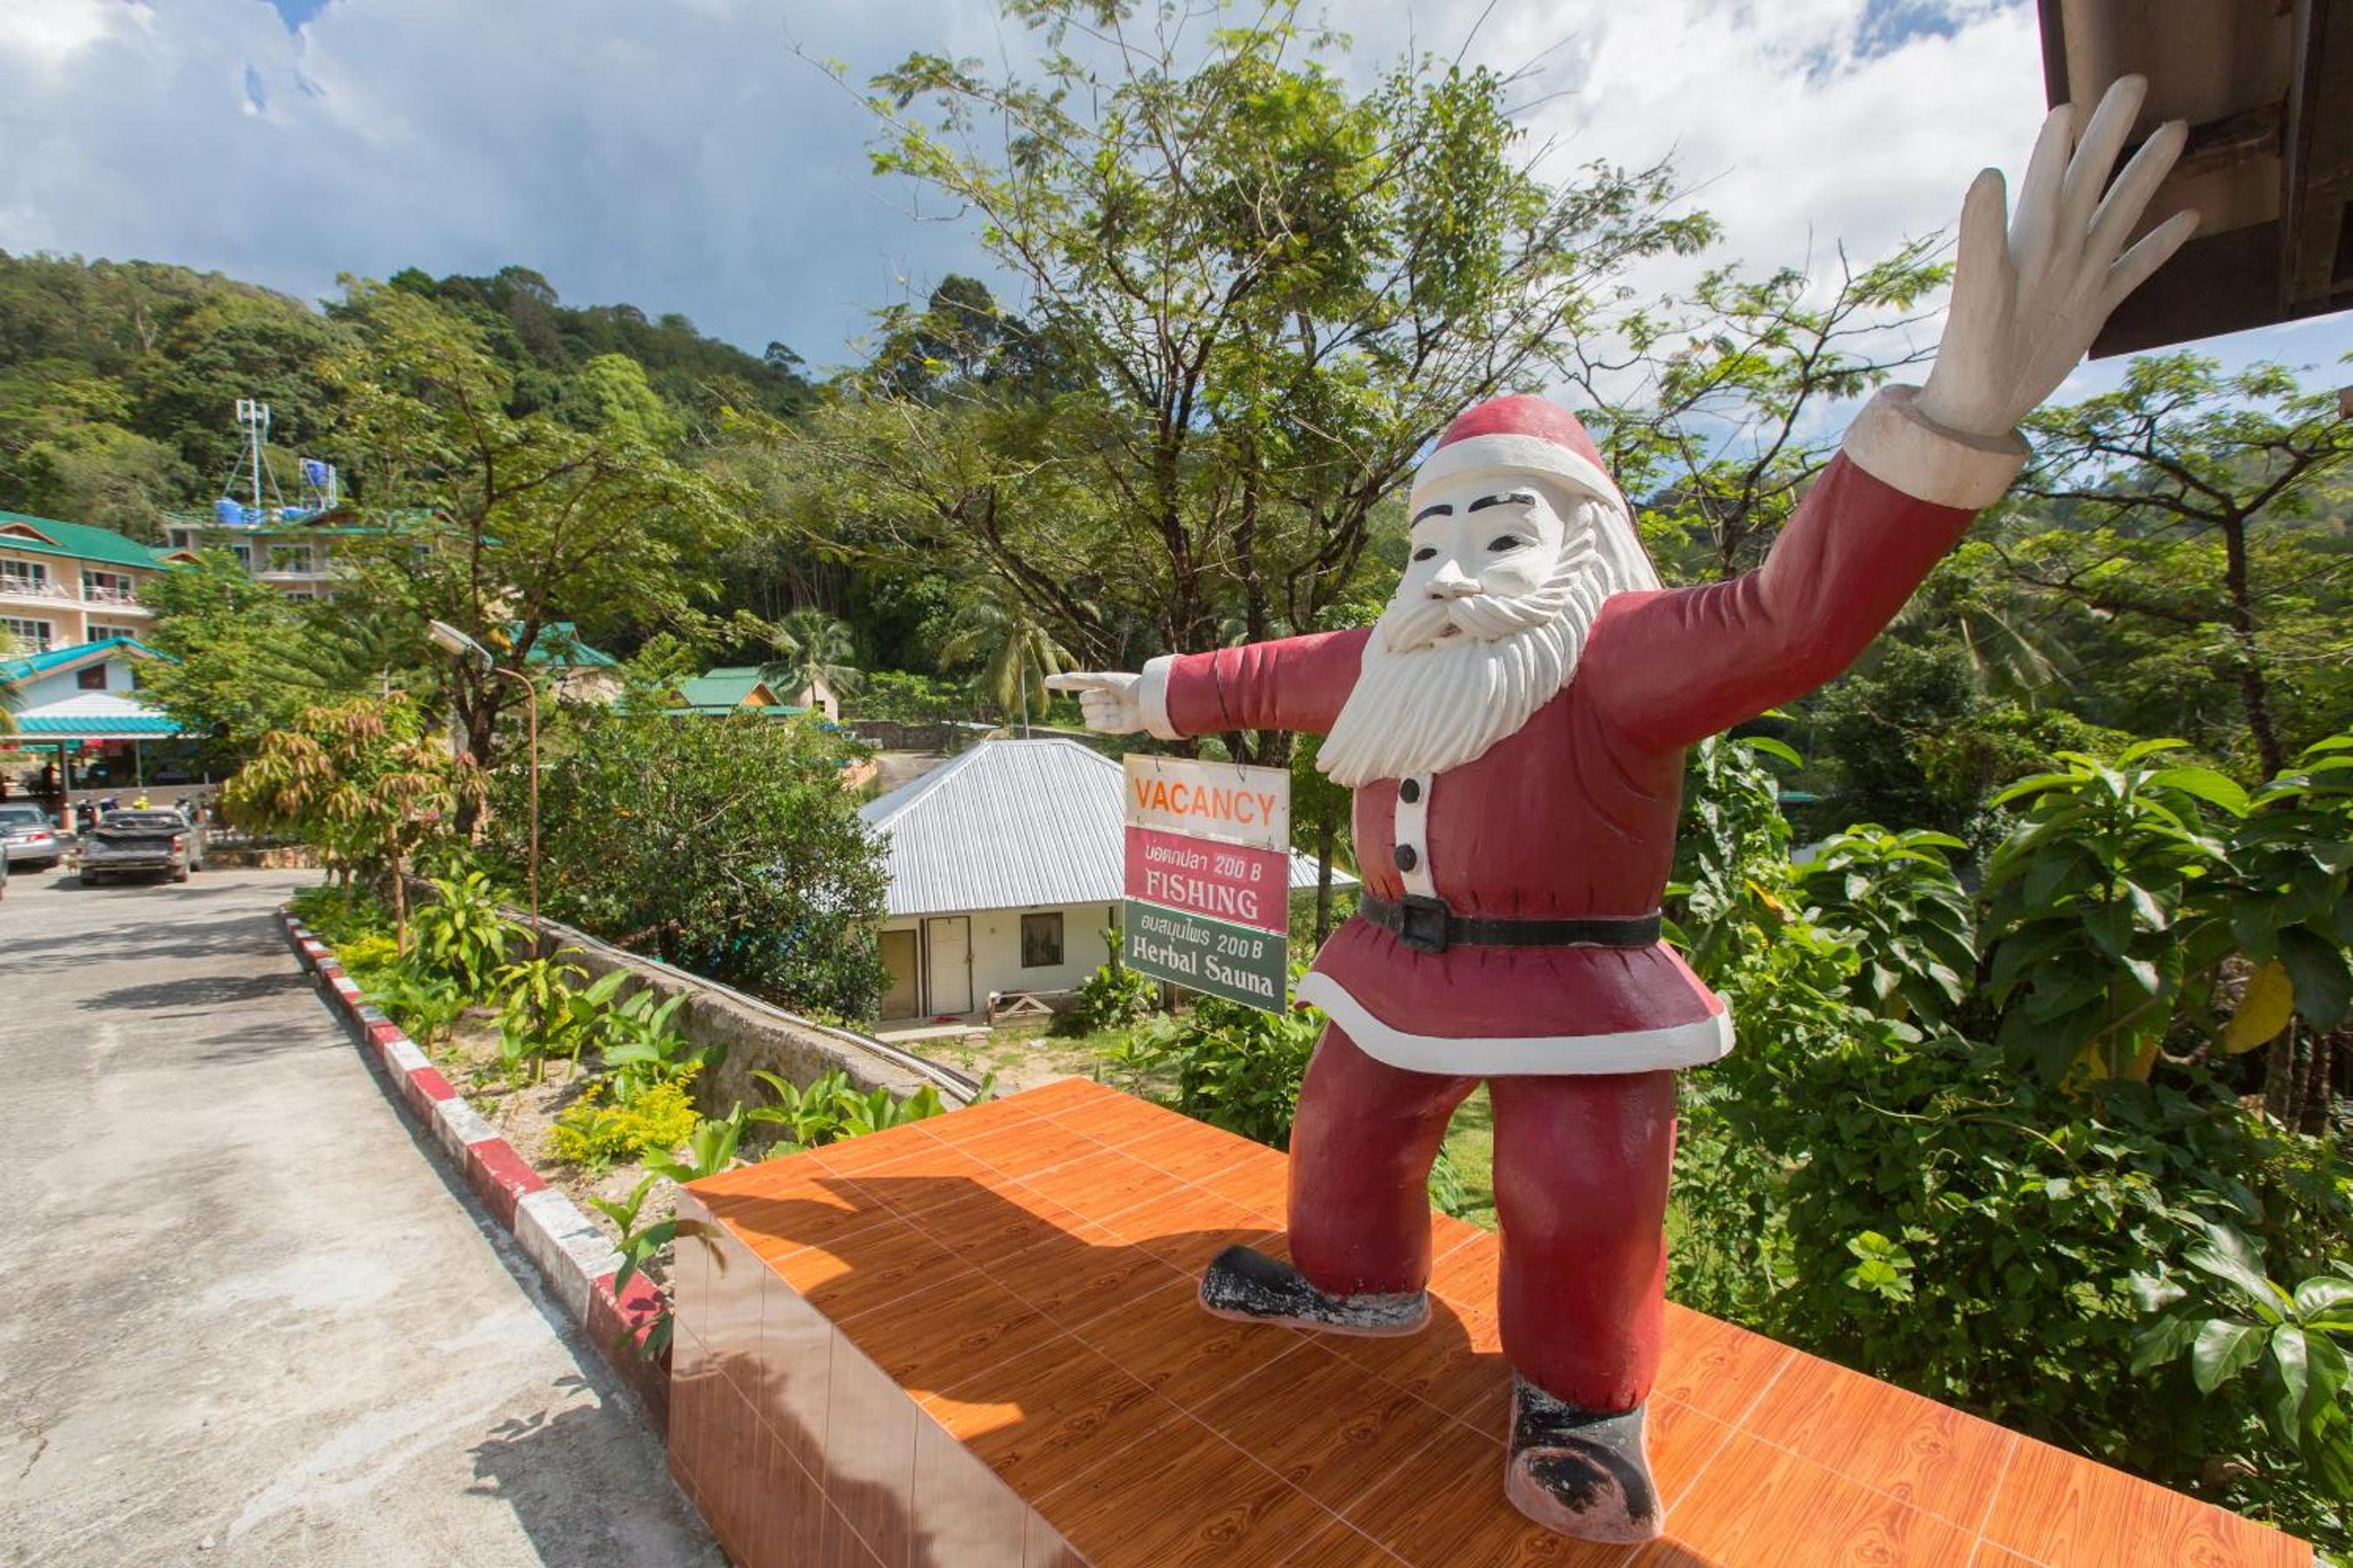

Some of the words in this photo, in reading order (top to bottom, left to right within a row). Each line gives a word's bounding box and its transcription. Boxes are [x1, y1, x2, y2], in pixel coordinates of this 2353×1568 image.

[1134, 777, 1277, 828] VACANCY
[1145, 867, 1258, 920] FISHING
[1215, 855, 1245, 876] 200
[1251, 863, 1262, 882] B
[1141, 915, 1210, 946] อบสมุนไพร
[1218, 935, 1248, 959] 200
[1252, 939, 1263, 959] B
[1133, 935, 1197, 975] Herbal
[1205, 955, 1274, 999] Sauna
